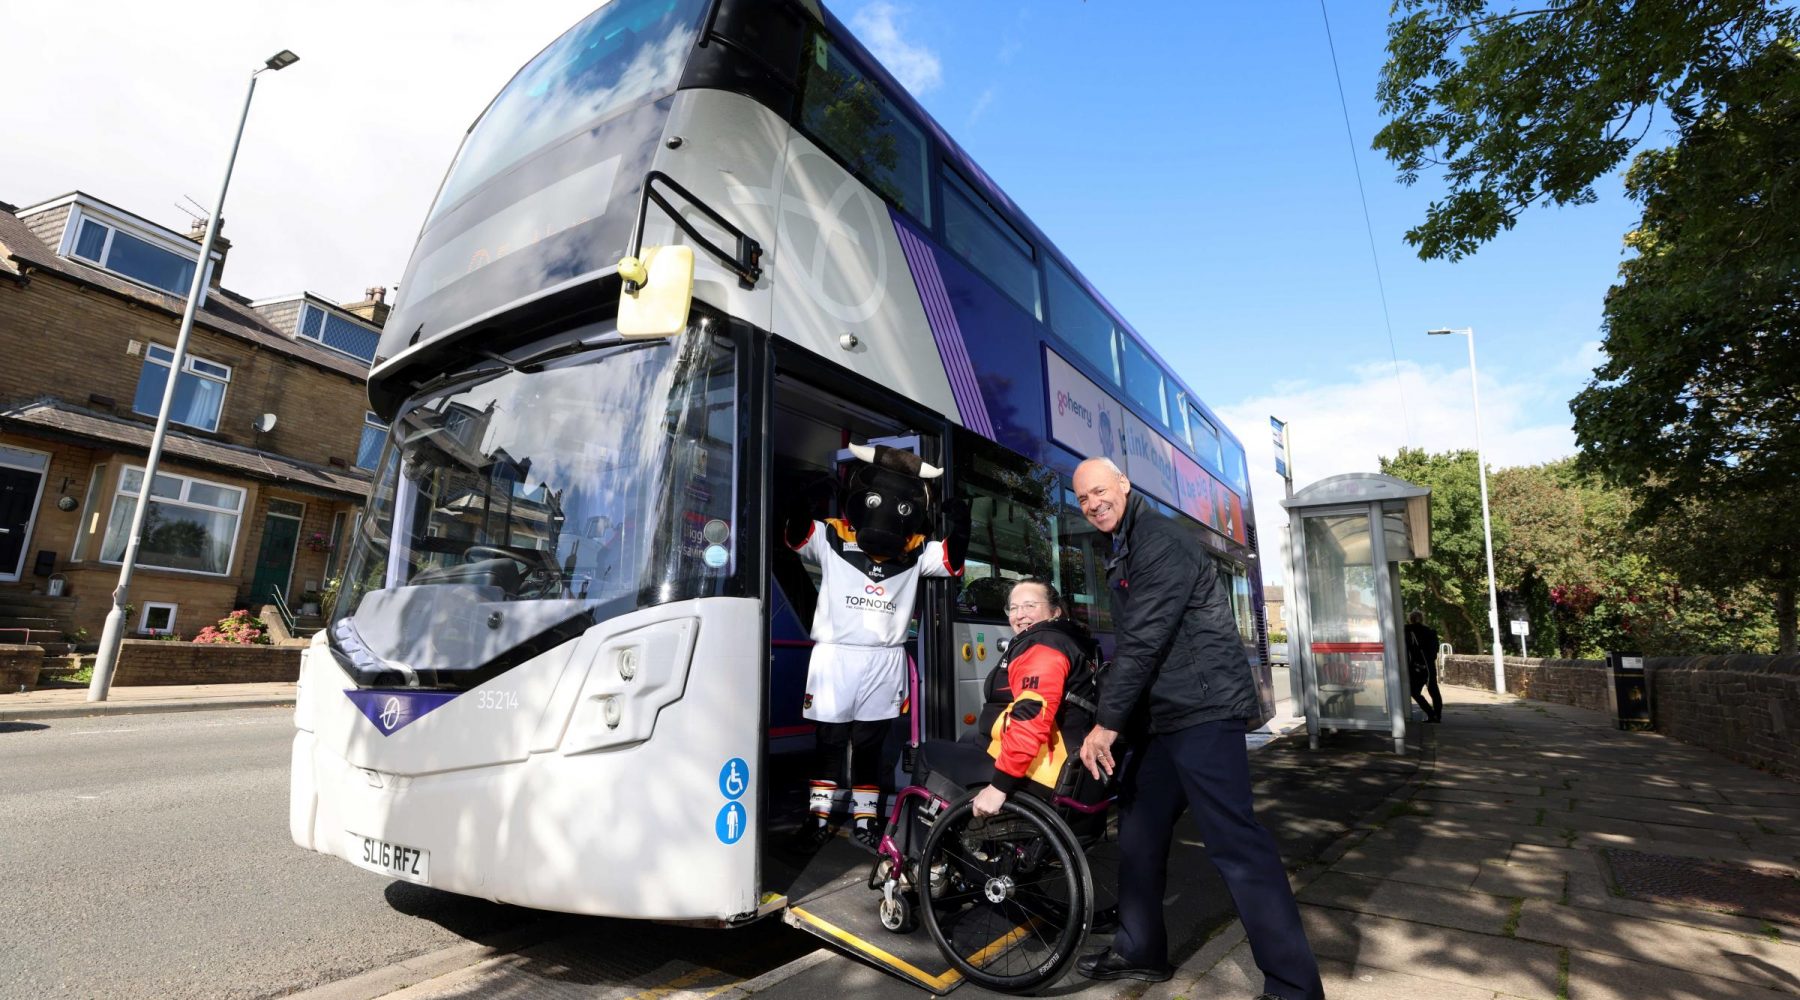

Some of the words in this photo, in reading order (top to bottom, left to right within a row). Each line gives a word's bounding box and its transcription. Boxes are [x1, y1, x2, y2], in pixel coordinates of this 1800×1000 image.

[1058, 391, 1092, 428] gohenry
[846, 596, 897, 612] TOPNOTCH
[1022, 676, 1039, 690] CH
[478, 690, 520, 710] 35214
[363, 838, 391, 867] SL16
[393, 845, 421, 875] RFZ
